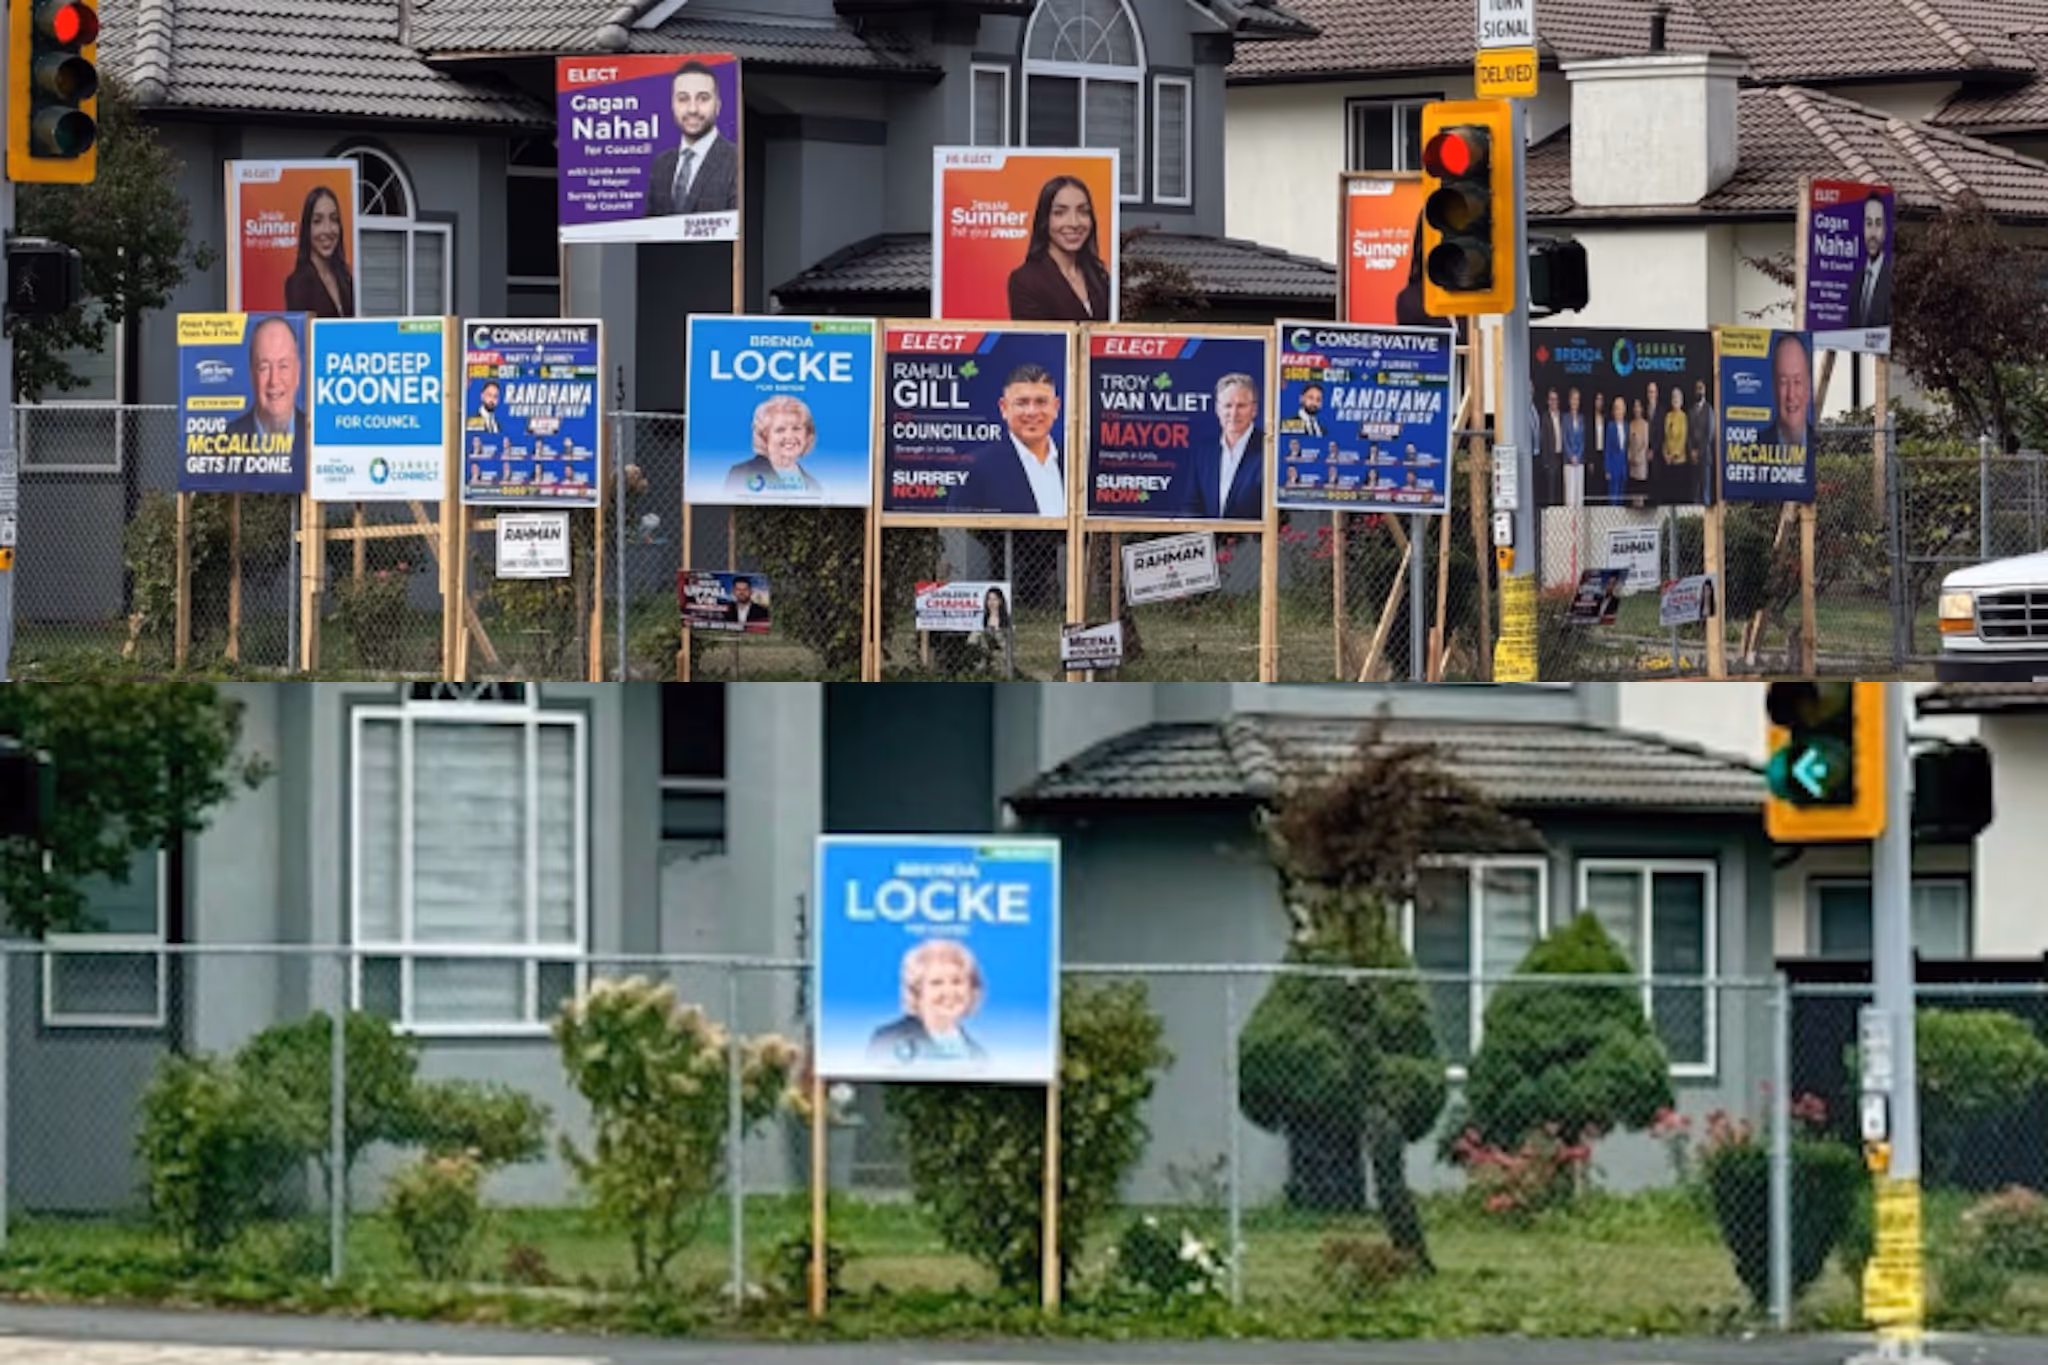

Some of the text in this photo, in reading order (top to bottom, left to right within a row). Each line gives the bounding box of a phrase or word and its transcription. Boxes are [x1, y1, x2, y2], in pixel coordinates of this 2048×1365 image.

[1483, 20, 1529, 39] SIGNAL
[567, 68, 618, 82] ELECT
[1481, 64, 1533, 83] DELAYED
[571, 95, 639, 114] Gagan
[572, 114, 659, 140] Nahal
[584, 143, 652, 156] for Council
[684, 218, 731, 228] SURREY
[951, 207, 1028, 225] Sunner
[1814, 214, 1849, 233] Gagan
[245, 219, 297, 235] Sunner
[684, 227, 717, 237] FIRST
[1352, 240, 1408, 257] Sunner
[1814, 234, 1859, 258] Nahal
[492, 328, 589, 343] CONSERVATIVE
[750, 335, 814, 348] BRENDA
[901, 333, 966, 350] ELECT
[1315, 332, 1439, 351] CONSERVATIVE
[1105, 338, 1168, 355] ELECT
[1554, 347, 1603, 362] BRENDA
[326, 352, 431, 375] PARDEEP
[710, 350, 853, 382] LOCKE
[893, 362, 958, 380] RAHUL
[1635, 358, 1686, 371] CONNECT
[316, 377, 440, 405] KOONER
[1101, 374, 1149, 391] TROY
[504, 383, 592, 404] RANDHAWA
[893, 380, 970, 409] GILL
[1101, 392, 1212, 412] VAN VLIET
[1330, 386, 1442, 412] RANDHAWA
[186, 417, 226, 433] DOUG
[335, 414, 421, 429] FOR COUNCIL
[893, 421, 1001, 441] COUNCILLOR
[1100, 422, 1189, 448] MAYOR
[1726, 427, 1757, 442] DOUG
[186, 433, 294, 454] McCALLUM
[1726, 444, 1807, 464] McCALLUM
[186, 456, 293, 474] GETS IT DONE.
[1726, 465, 1756, 482] GETS
[1759, 466, 1769, 482] IT
[389, 470, 439, 481] CONNECT
[893, 470, 970, 486] SURREY
[1096, 474, 1172, 490] SURREY
[892, 486, 937, 498] NOW
[1096, 490, 1138, 502] NOW
[504, 528, 561, 542] RAHMAN
[1611, 541, 1655, 555] RAHMAN
[1134, 546, 1206, 570] RAHMAN
[845, 879, 1031, 923] LOCKE
